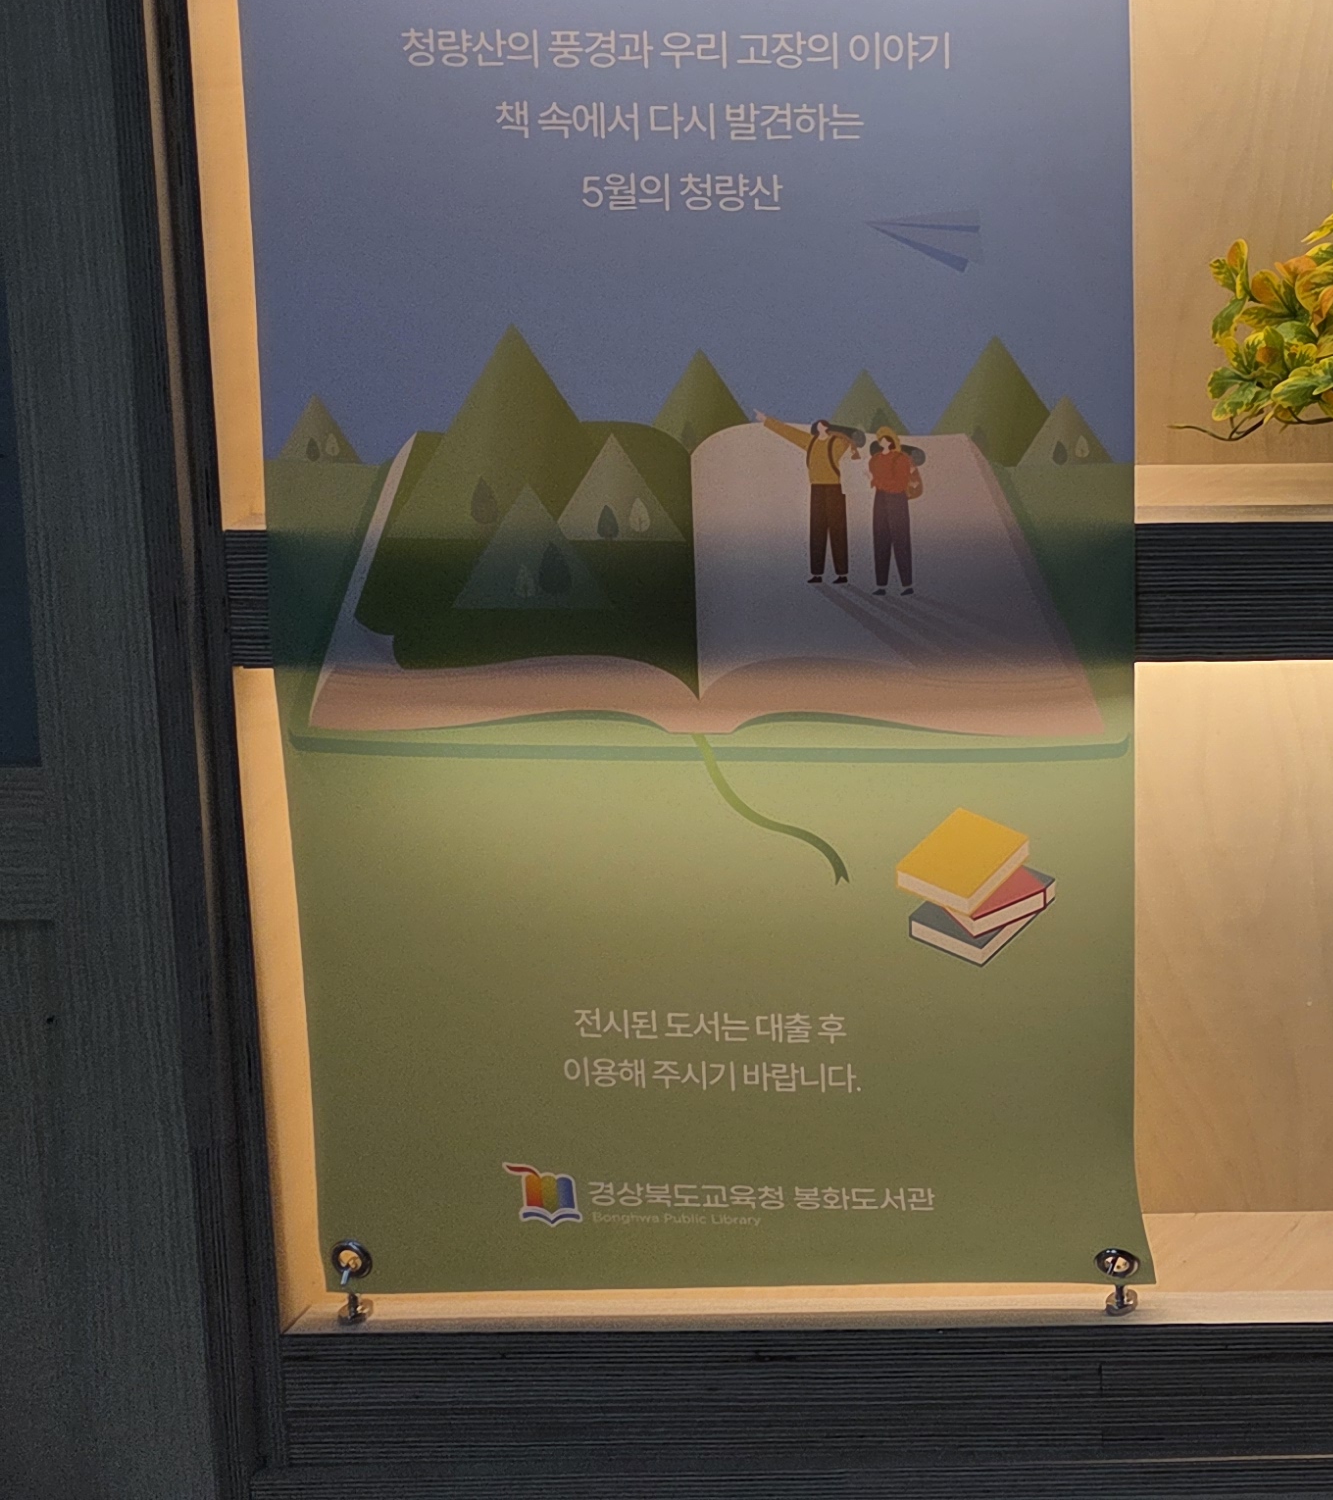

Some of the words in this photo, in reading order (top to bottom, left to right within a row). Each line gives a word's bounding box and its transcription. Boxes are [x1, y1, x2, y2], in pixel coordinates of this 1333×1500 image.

[401, 29, 540, 68] 청량산의
[547, 30, 654, 69] 풍경과
[660, 32, 727, 70] 우리
[737, 31, 840, 70] 고장의
[849, 31, 951, 71] 이야기
[495, 102, 530, 138] 책
[536, 102, 639, 141] 속에서
[649, 103, 716, 141] 다시
[725, 104, 865, 141] 발견하는
[581, 174, 671, 212] 5월의
[679, 175, 783, 213] 청량산
[574, 1008, 659, 1039] 전시된
[664, 1012, 751, 1043] 도서는
[755, 1013, 812, 1044] 대출
[817, 1013, 847, 1045] 후
[563, 1056, 646, 1089] 이용해
[652, 1060, 737, 1092] 주시기
[742, 1062, 862, 1094] 바랍니다.
[587, 1181, 785, 1211] 경상북도교육청
[793, 1186, 936, 1213] 봉화도서관
